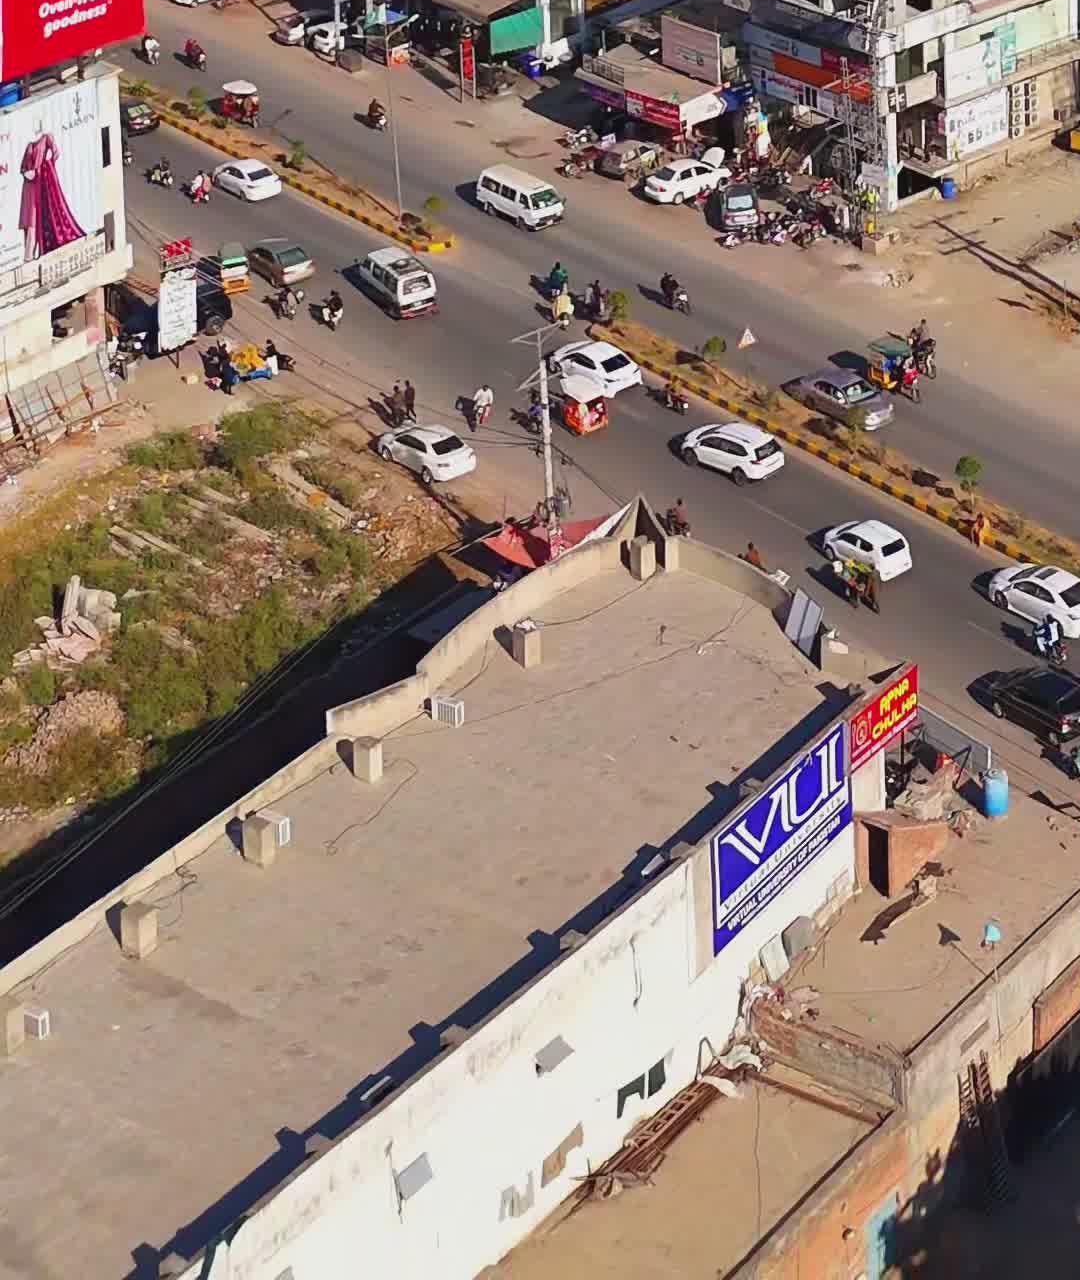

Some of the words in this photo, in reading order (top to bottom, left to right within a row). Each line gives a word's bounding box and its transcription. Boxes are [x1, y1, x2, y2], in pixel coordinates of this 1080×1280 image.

[43, 3, 108, 38] goodness
[872, 693, 917, 740] CHULHA
[879, 678, 910, 717] APNA
[724, 863, 771, 911] Virtual
[774, 797, 842, 863] University
[727, 896, 759, 930] VIRTUAL
[757, 856, 799, 900] UNIVERSITY
[808, 815, 841, 852] PAKISTAN
